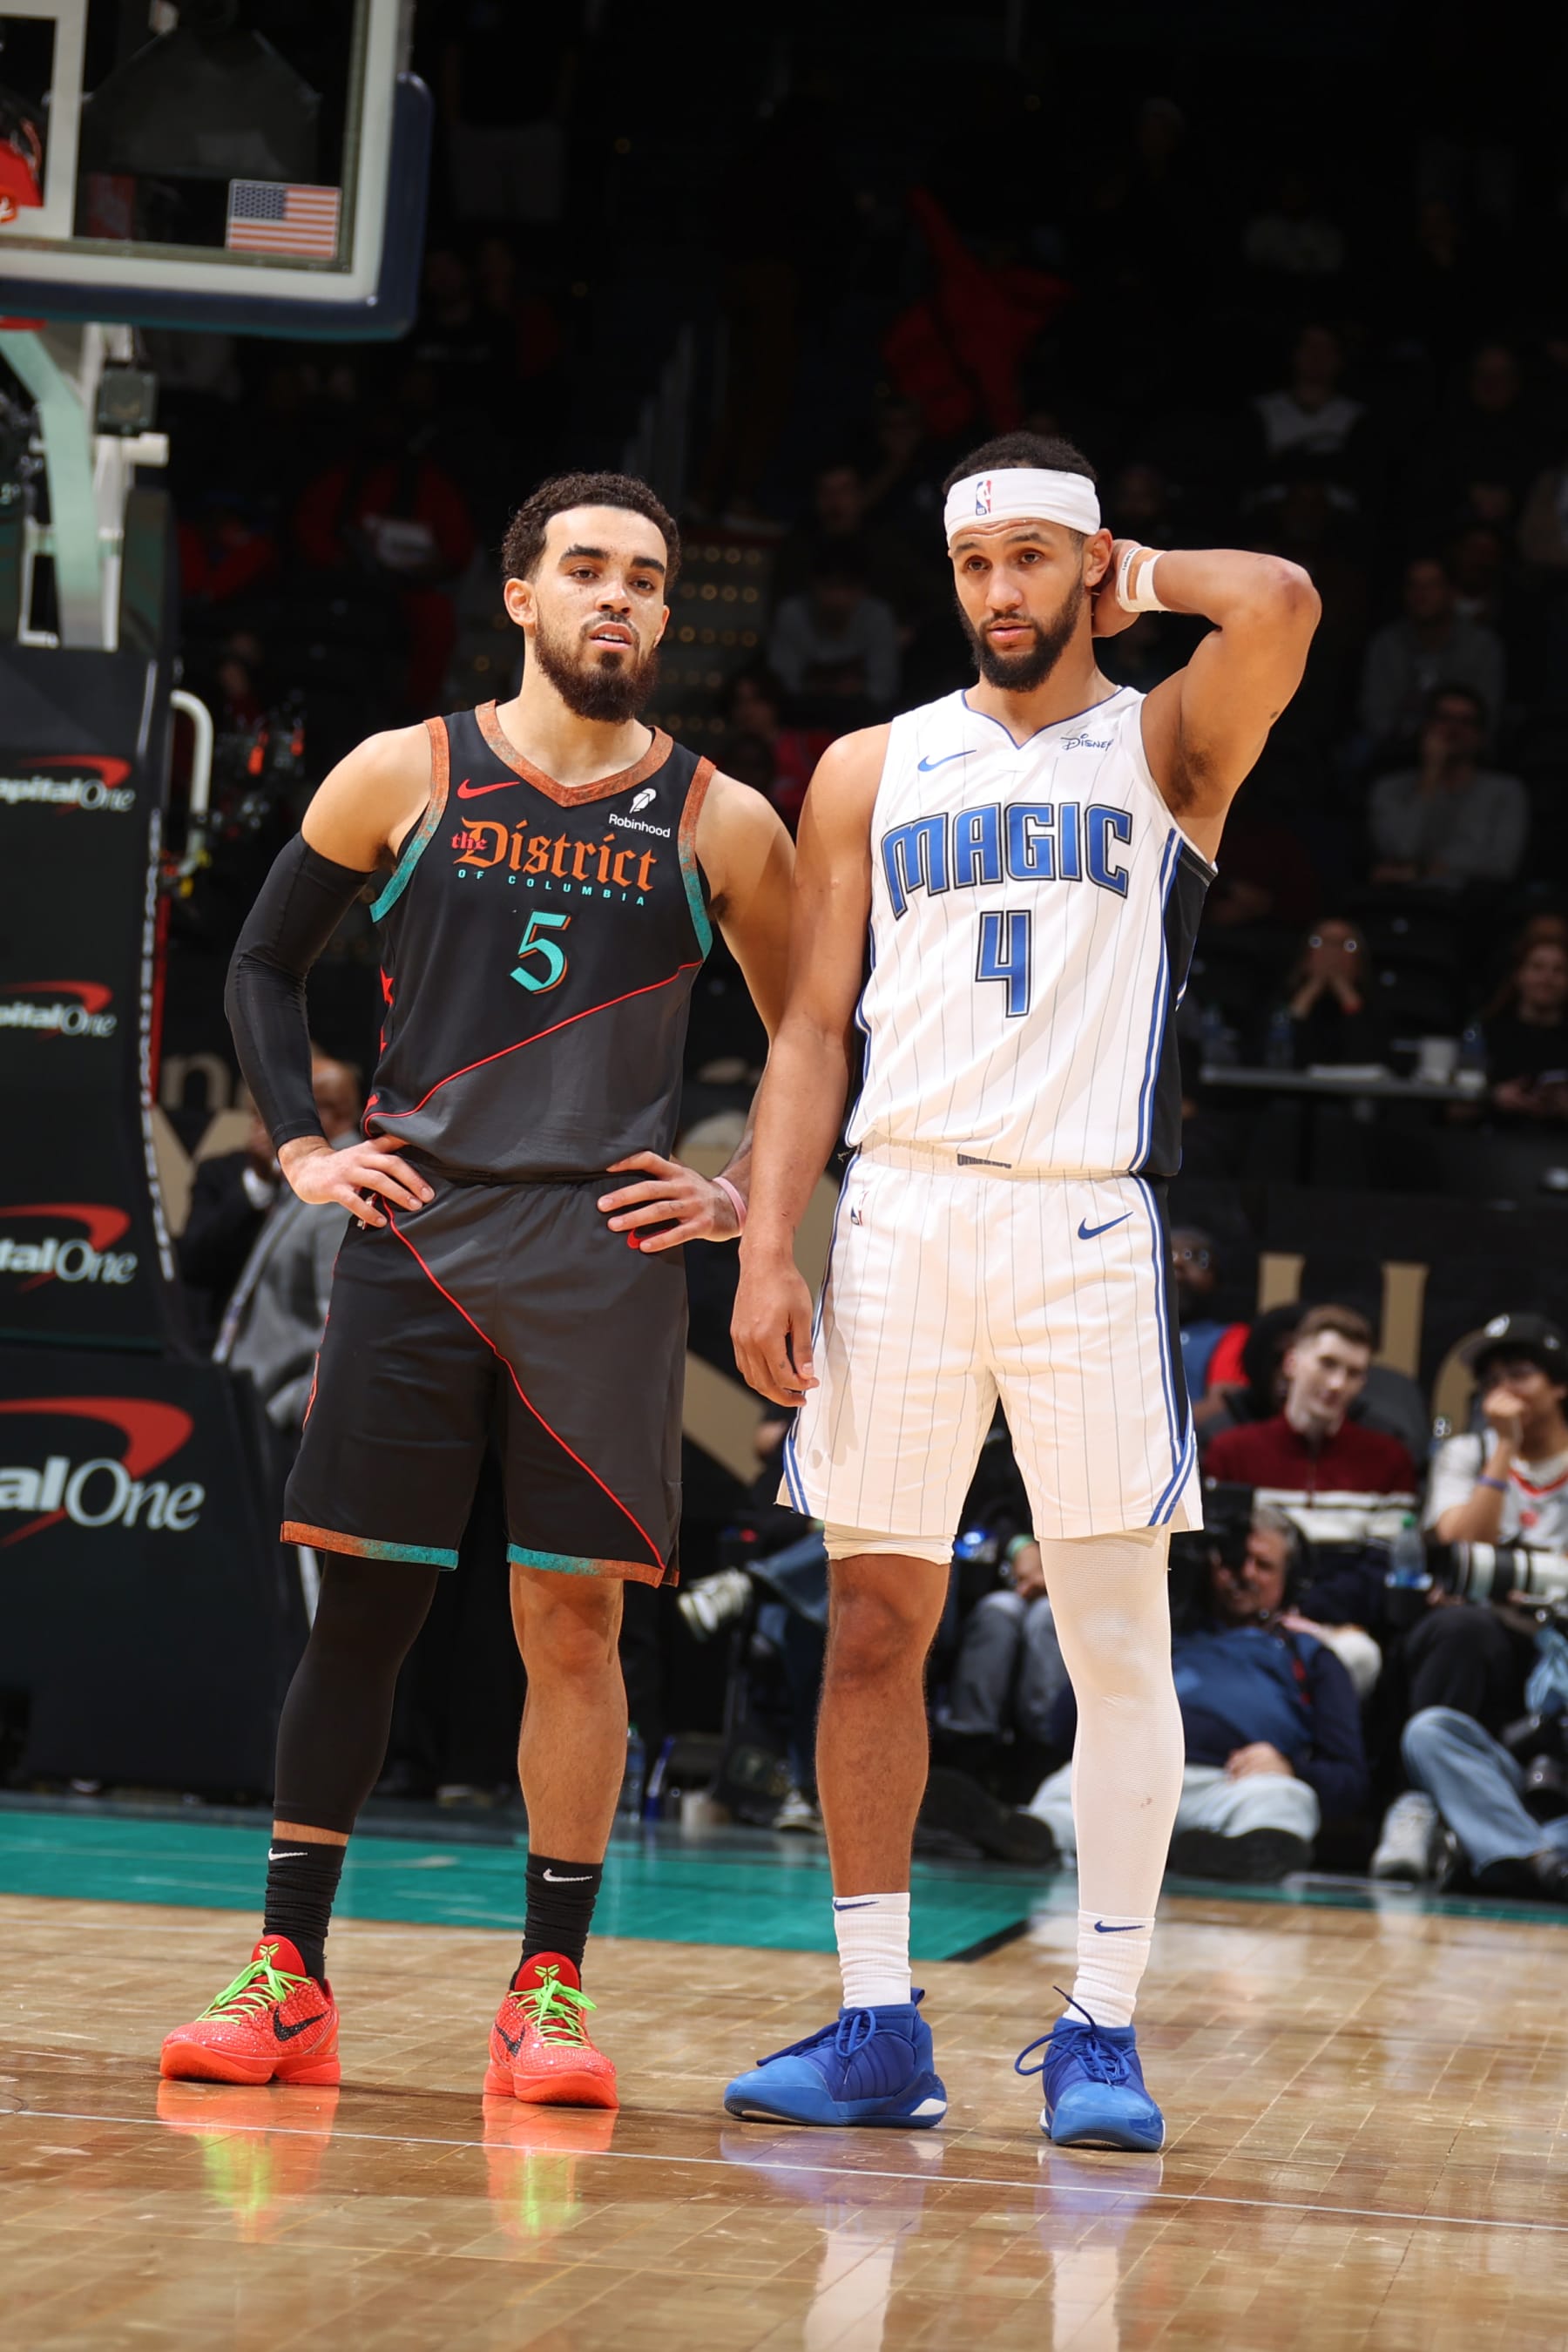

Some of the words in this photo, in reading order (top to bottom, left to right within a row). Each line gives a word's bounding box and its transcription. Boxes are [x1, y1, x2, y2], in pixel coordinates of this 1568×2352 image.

[450, 830, 488, 851] the
[452, 816, 658, 892] District
[609, 814, 671, 838] Robinhood
[881, 801, 1132, 921] MAGIC
[457, 868, 484, 880] OF
[507, 875, 645, 906] COLUMBIA
[510, 910, 571, 994] 5
[975, 909, 1032, 1018] 4
